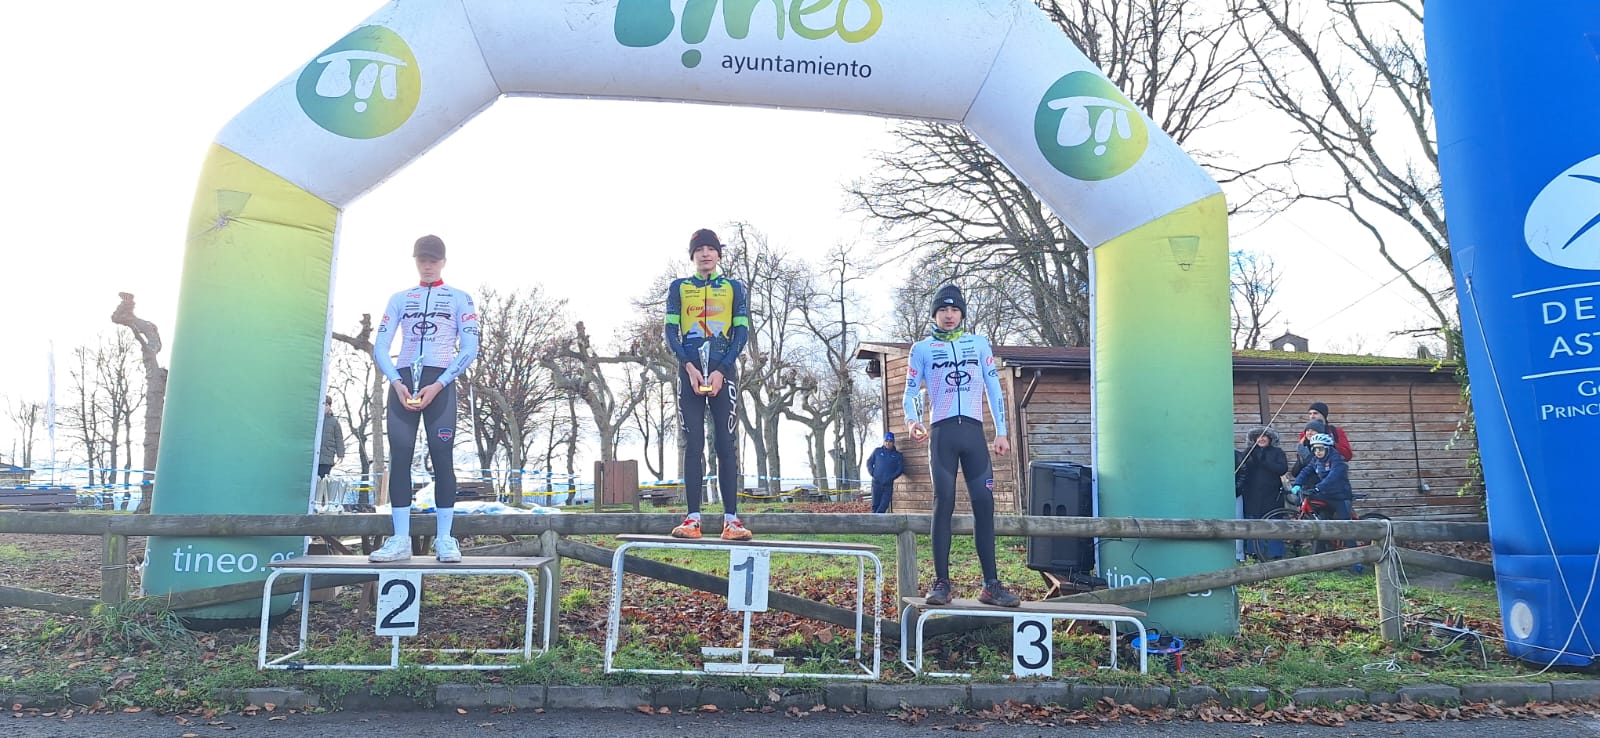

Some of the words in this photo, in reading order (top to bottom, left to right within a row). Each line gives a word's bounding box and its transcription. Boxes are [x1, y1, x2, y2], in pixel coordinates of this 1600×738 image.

[721, 54, 873, 78] ayuntamiento
[931, 359, 979, 370] MMR
[380, 579, 416, 628] 2
[733, 556, 754, 606] 1
[1017, 620, 1049, 669] 3
